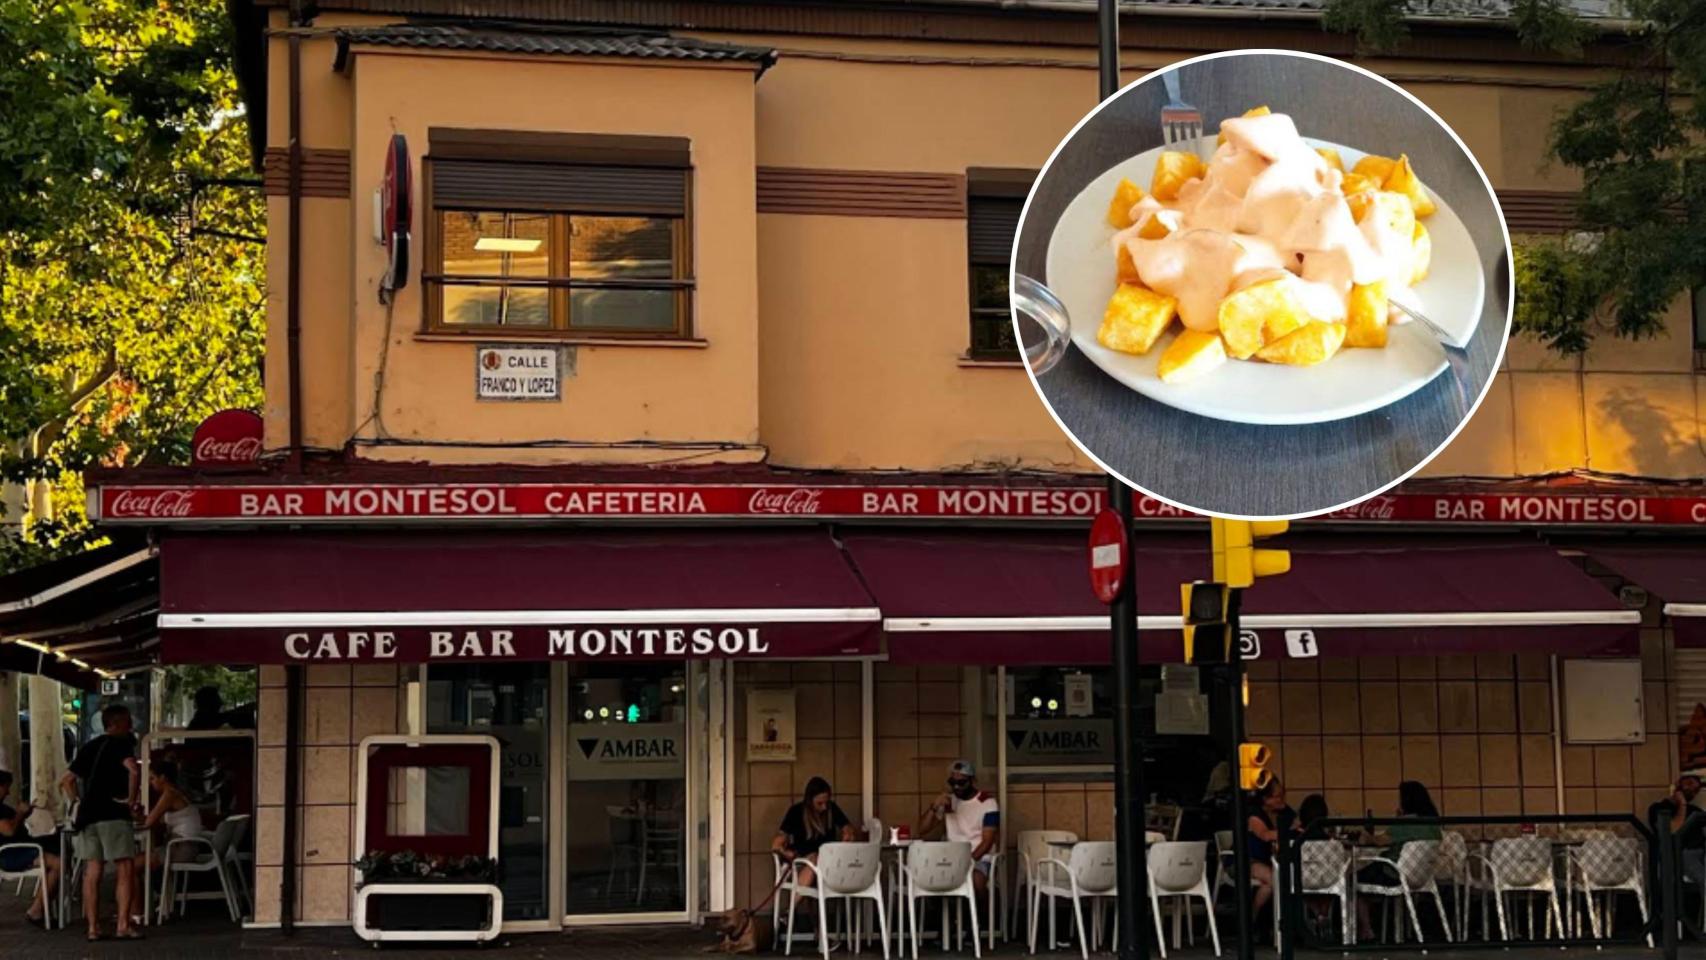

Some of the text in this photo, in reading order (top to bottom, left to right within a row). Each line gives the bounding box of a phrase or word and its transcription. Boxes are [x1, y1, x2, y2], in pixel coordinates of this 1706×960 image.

[508, 356, 548, 368] CALLE
[481, 377, 555, 393] FRANCO Y LOPEZ
[111, 490, 196, 516] Coca-Cola
[241, 494, 303, 515] BAR
[326, 489, 516, 514] MONTESOL
[545, 491, 706, 513] CAFETERIA
[748, 488, 823, 513] Coca-Cola
[863, 493, 918, 513] BAR
[1435, 499, 1484, 519] BAR
[1500, 497, 1654, 521] MONTESOL
[284, 627, 769, 659] CAFE BAR MONTESOL
[600, 738, 677, 758] AMBAR
[1029, 730, 1101, 749] AMBAR
